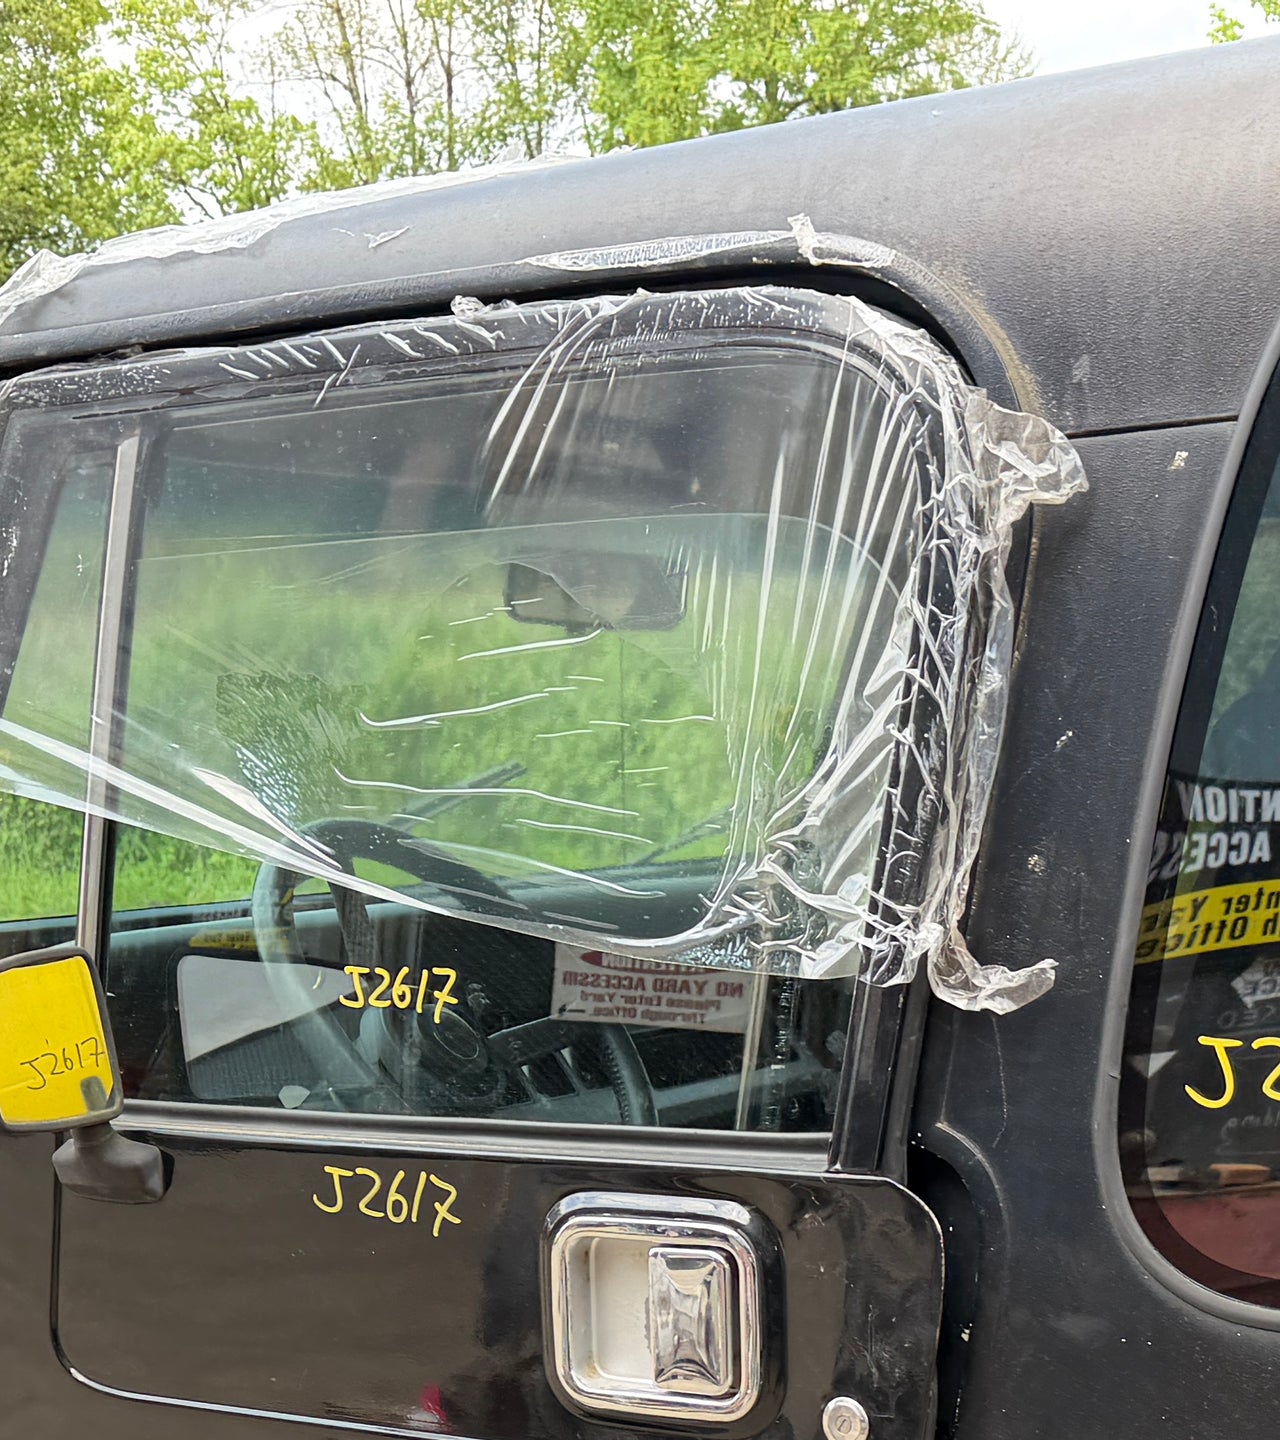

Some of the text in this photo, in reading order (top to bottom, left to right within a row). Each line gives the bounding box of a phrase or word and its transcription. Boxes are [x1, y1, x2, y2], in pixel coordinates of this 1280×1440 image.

[338, 965, 459, 1024] J2617
[19, 1036, 105, 1091] J2617
[312, 1164, 462, 1238] J2617
